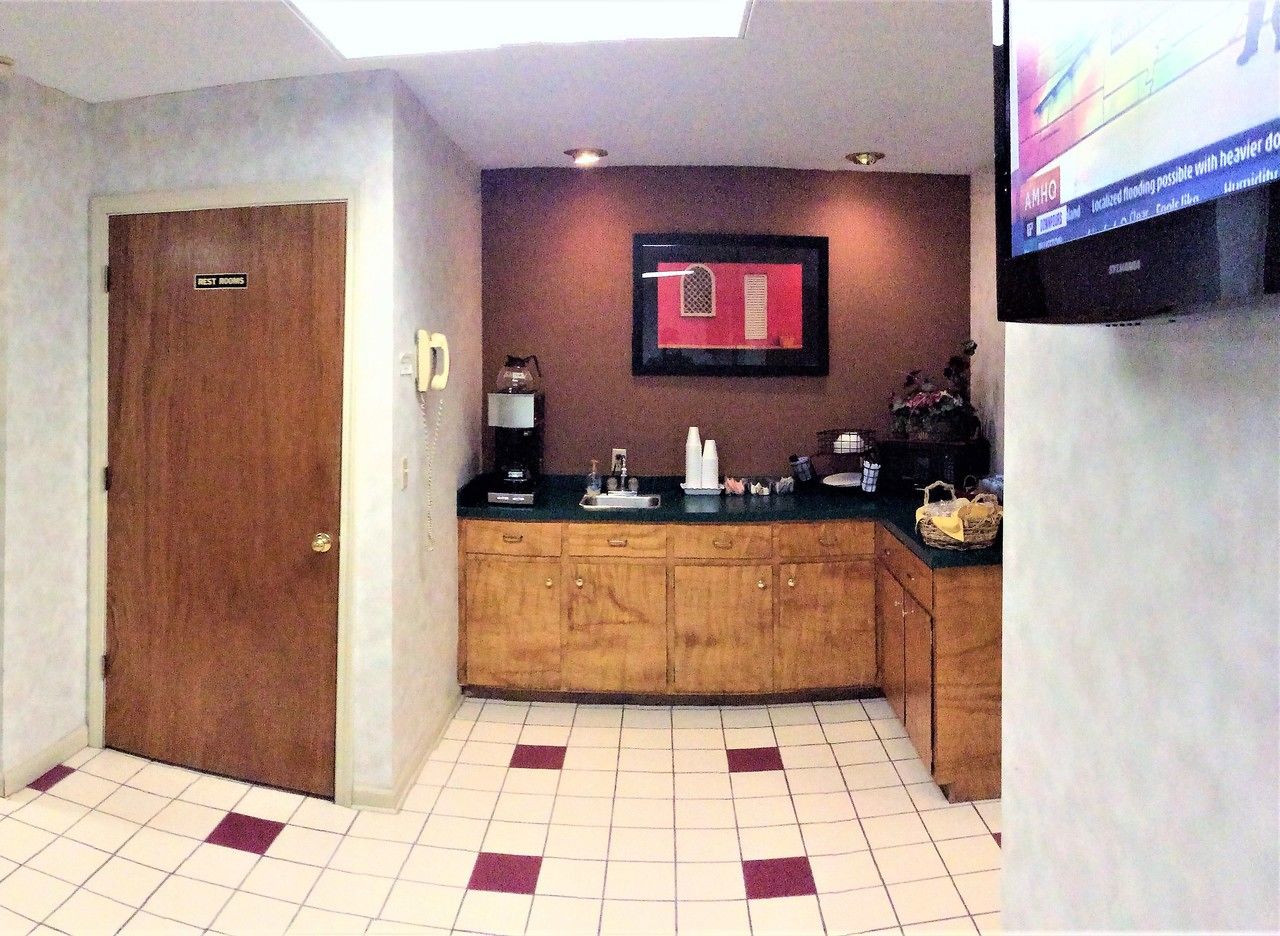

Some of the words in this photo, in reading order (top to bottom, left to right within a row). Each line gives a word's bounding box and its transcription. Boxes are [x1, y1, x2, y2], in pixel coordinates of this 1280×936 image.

[1092, 188, 1122, 213] Localized
[1123, 178, 1156, 202] flooding
[1157, 163, 1193, 192] possible
[1194, 153, 1218, 177] with
[1219, 138, 1263, 168] heavier
[197, 277, 217, 286] REST
[218, 276, 245, 285] ROOMS
